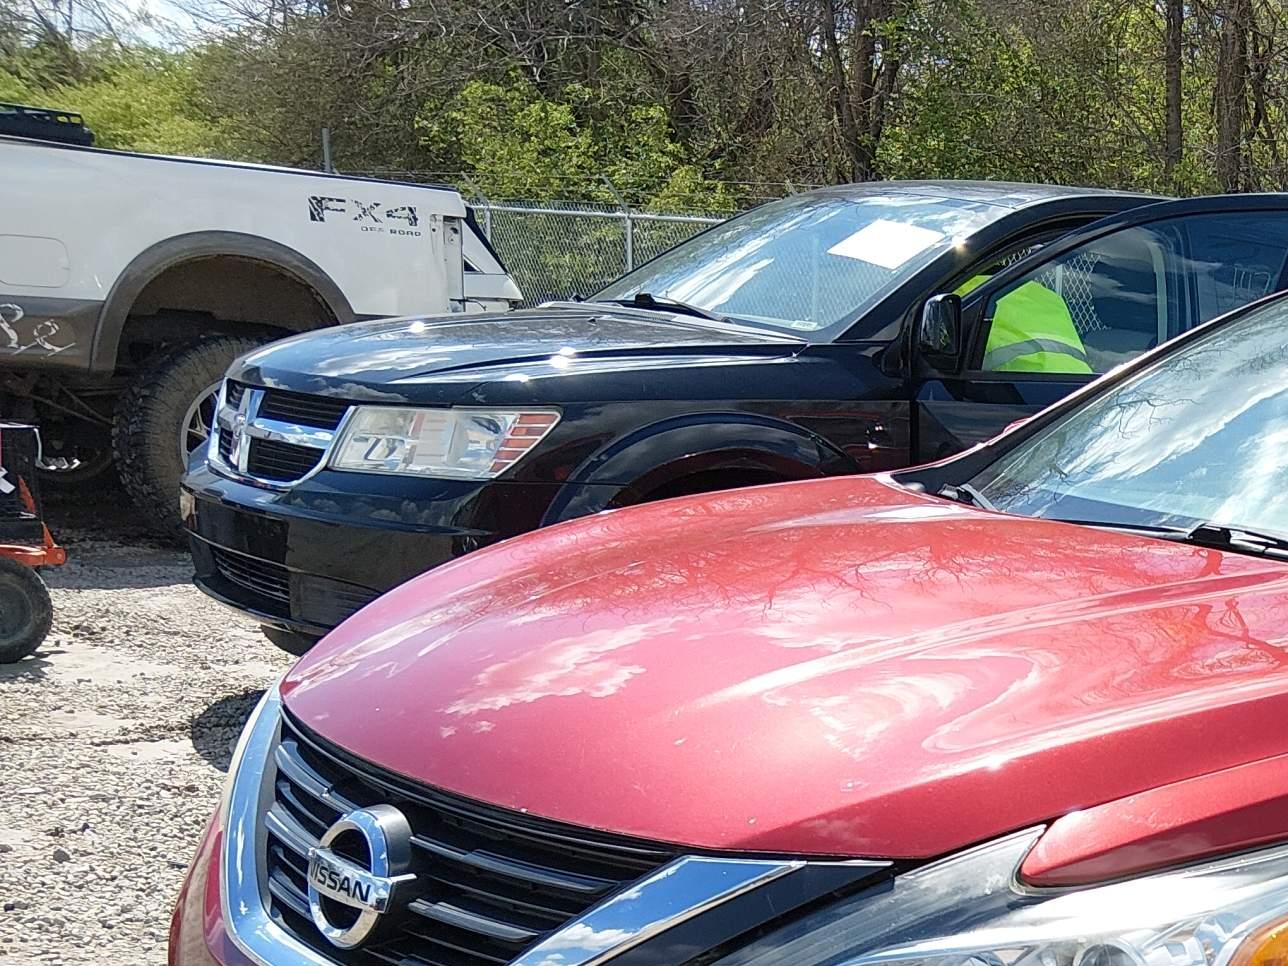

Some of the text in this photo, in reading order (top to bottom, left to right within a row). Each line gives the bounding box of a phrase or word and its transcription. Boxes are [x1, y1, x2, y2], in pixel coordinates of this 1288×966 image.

[308, 196, 418, 226] FX4
[390, 228, 421, 237] ROAD
[309, 863, 371, 902] NISSAN
